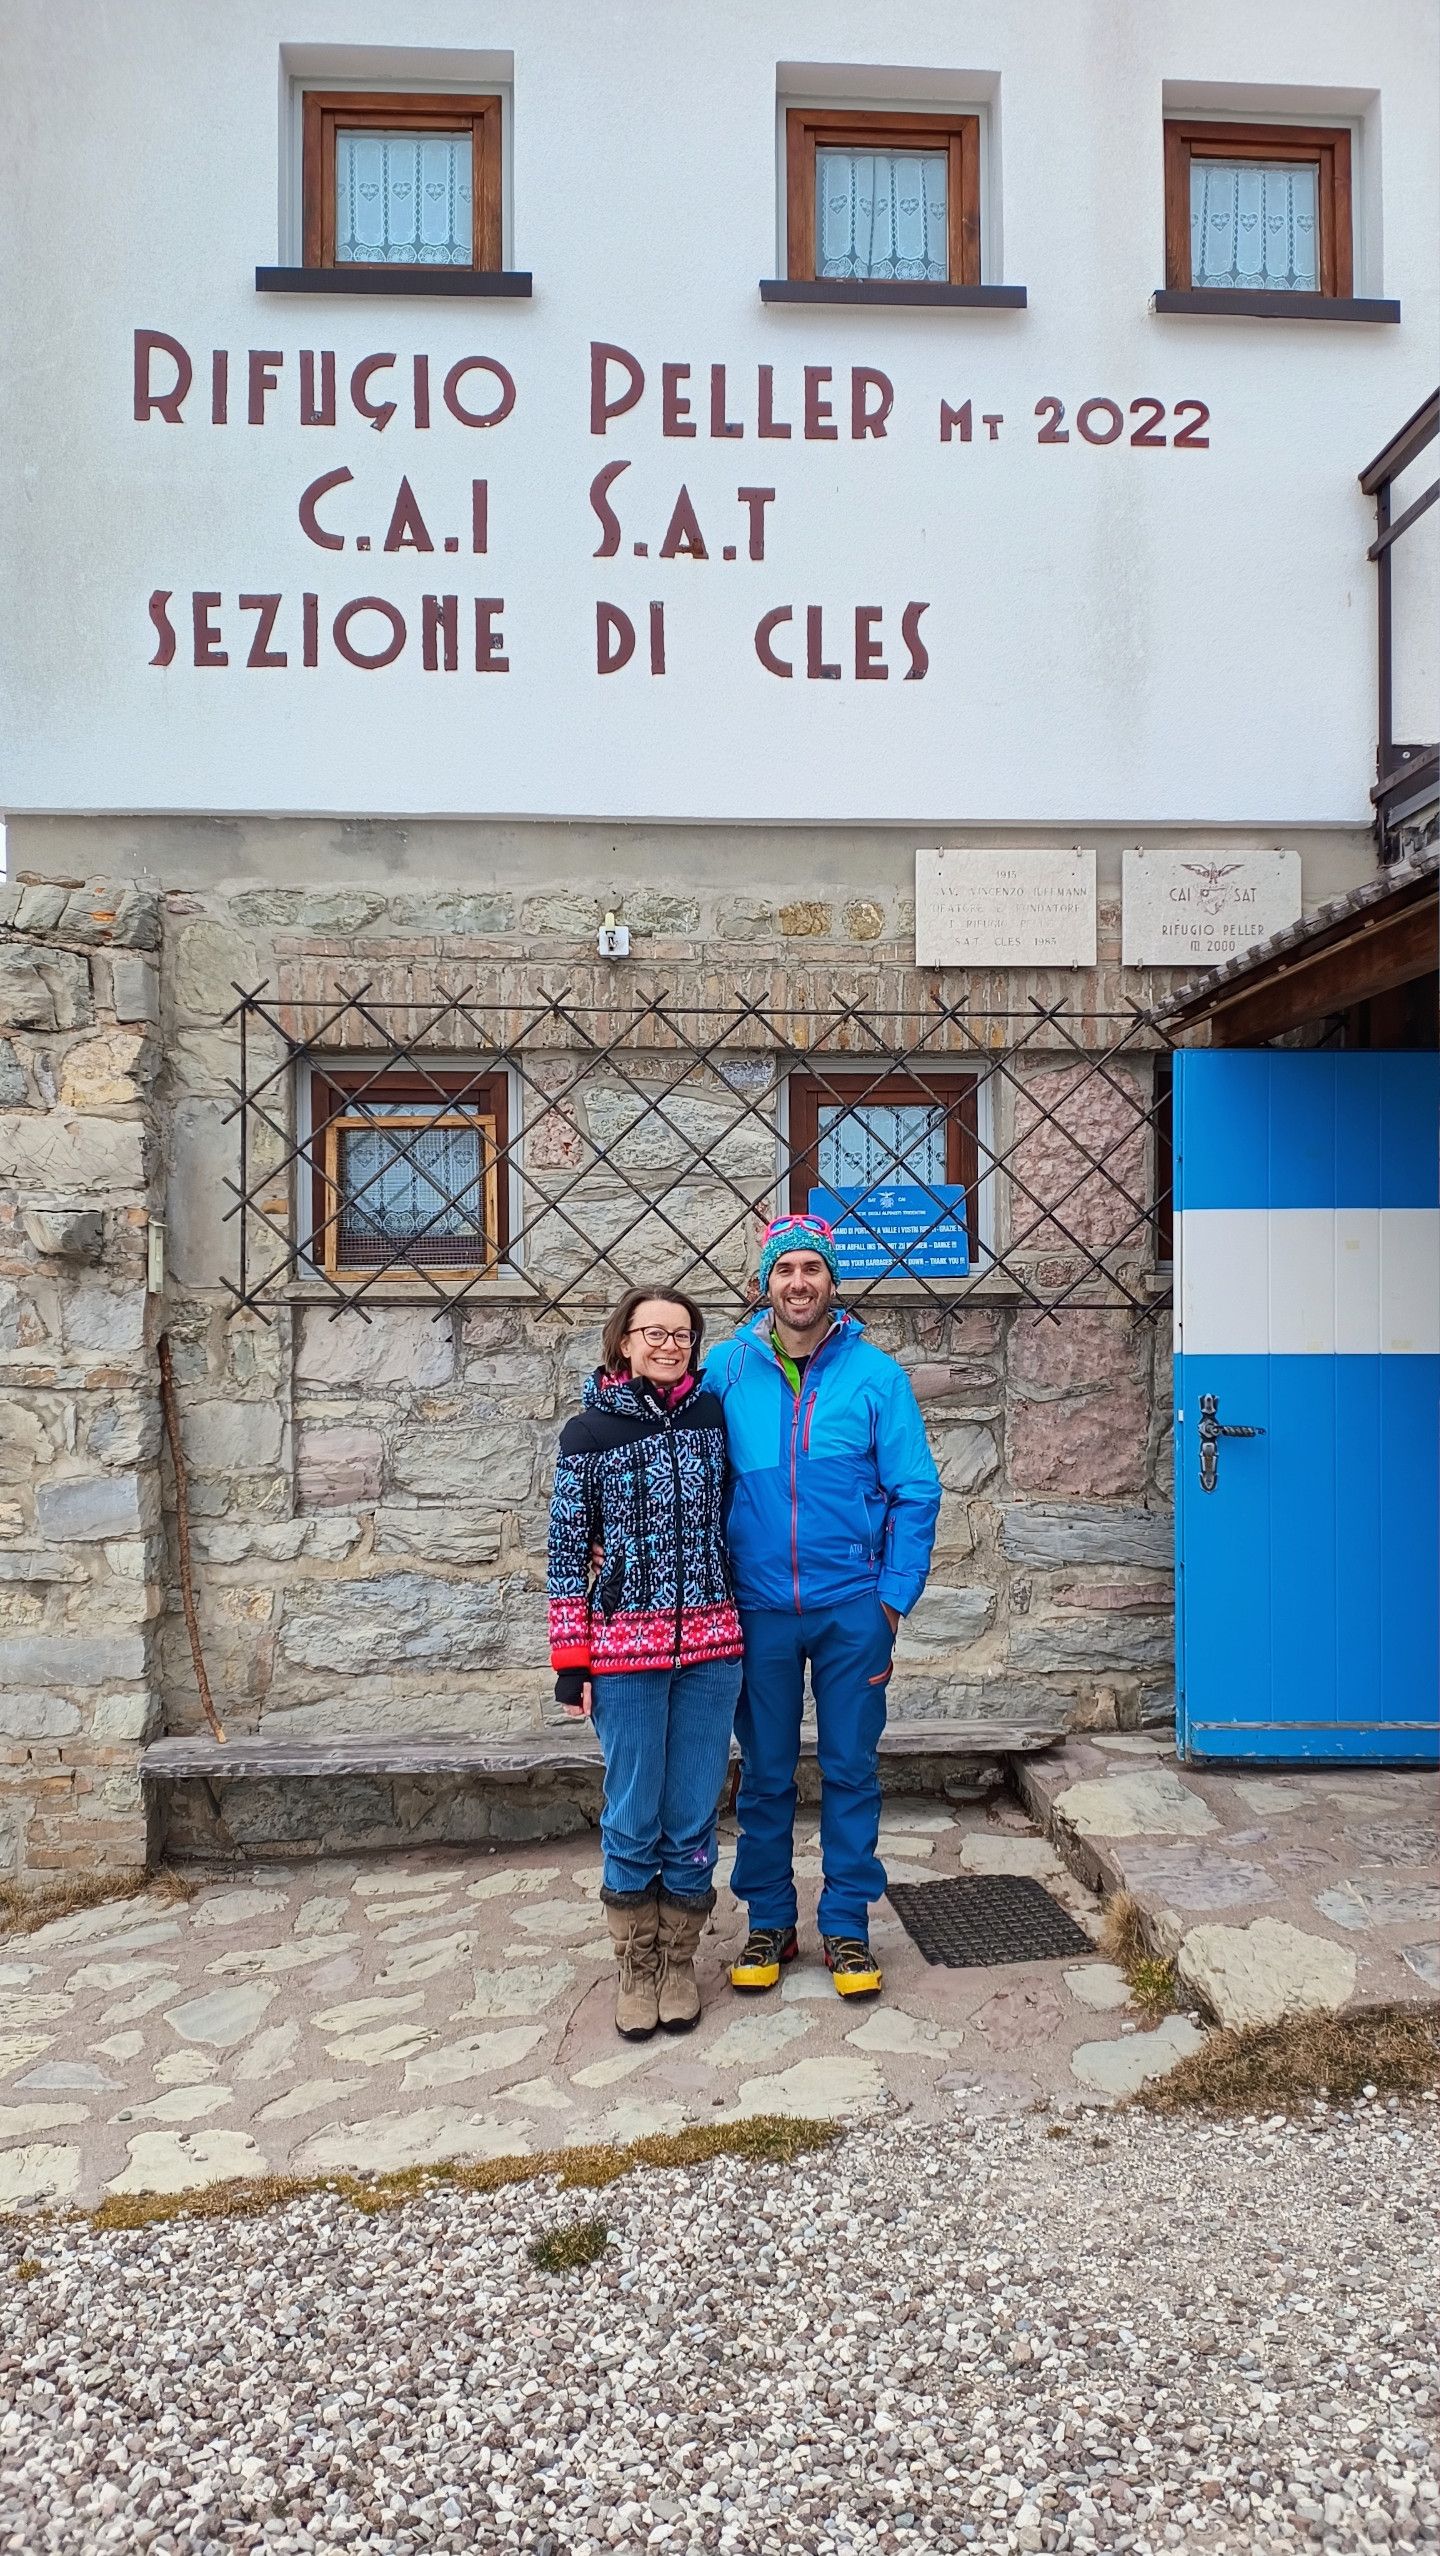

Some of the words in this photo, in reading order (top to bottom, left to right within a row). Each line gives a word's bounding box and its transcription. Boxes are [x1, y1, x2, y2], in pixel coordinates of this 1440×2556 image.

[590, 341, 894, 441] PELLER
[1036, 396, 1211, 449] 2022
[148, 589, 510, 673] SEZIONE
[596, 601, 666, 675] DI
[754, 602, 930, 680] CLES
[1169, 887, 1191, 902] CAI
[1234, 887, 1258, 902] SAT
[1162, 924, 1215, 936] RIFUGIO
[1223, 924, 1265, 935] PELLER
[1207, 940, 1236, 952] 2000
[881, 1226, 897, 1234] VALLE
